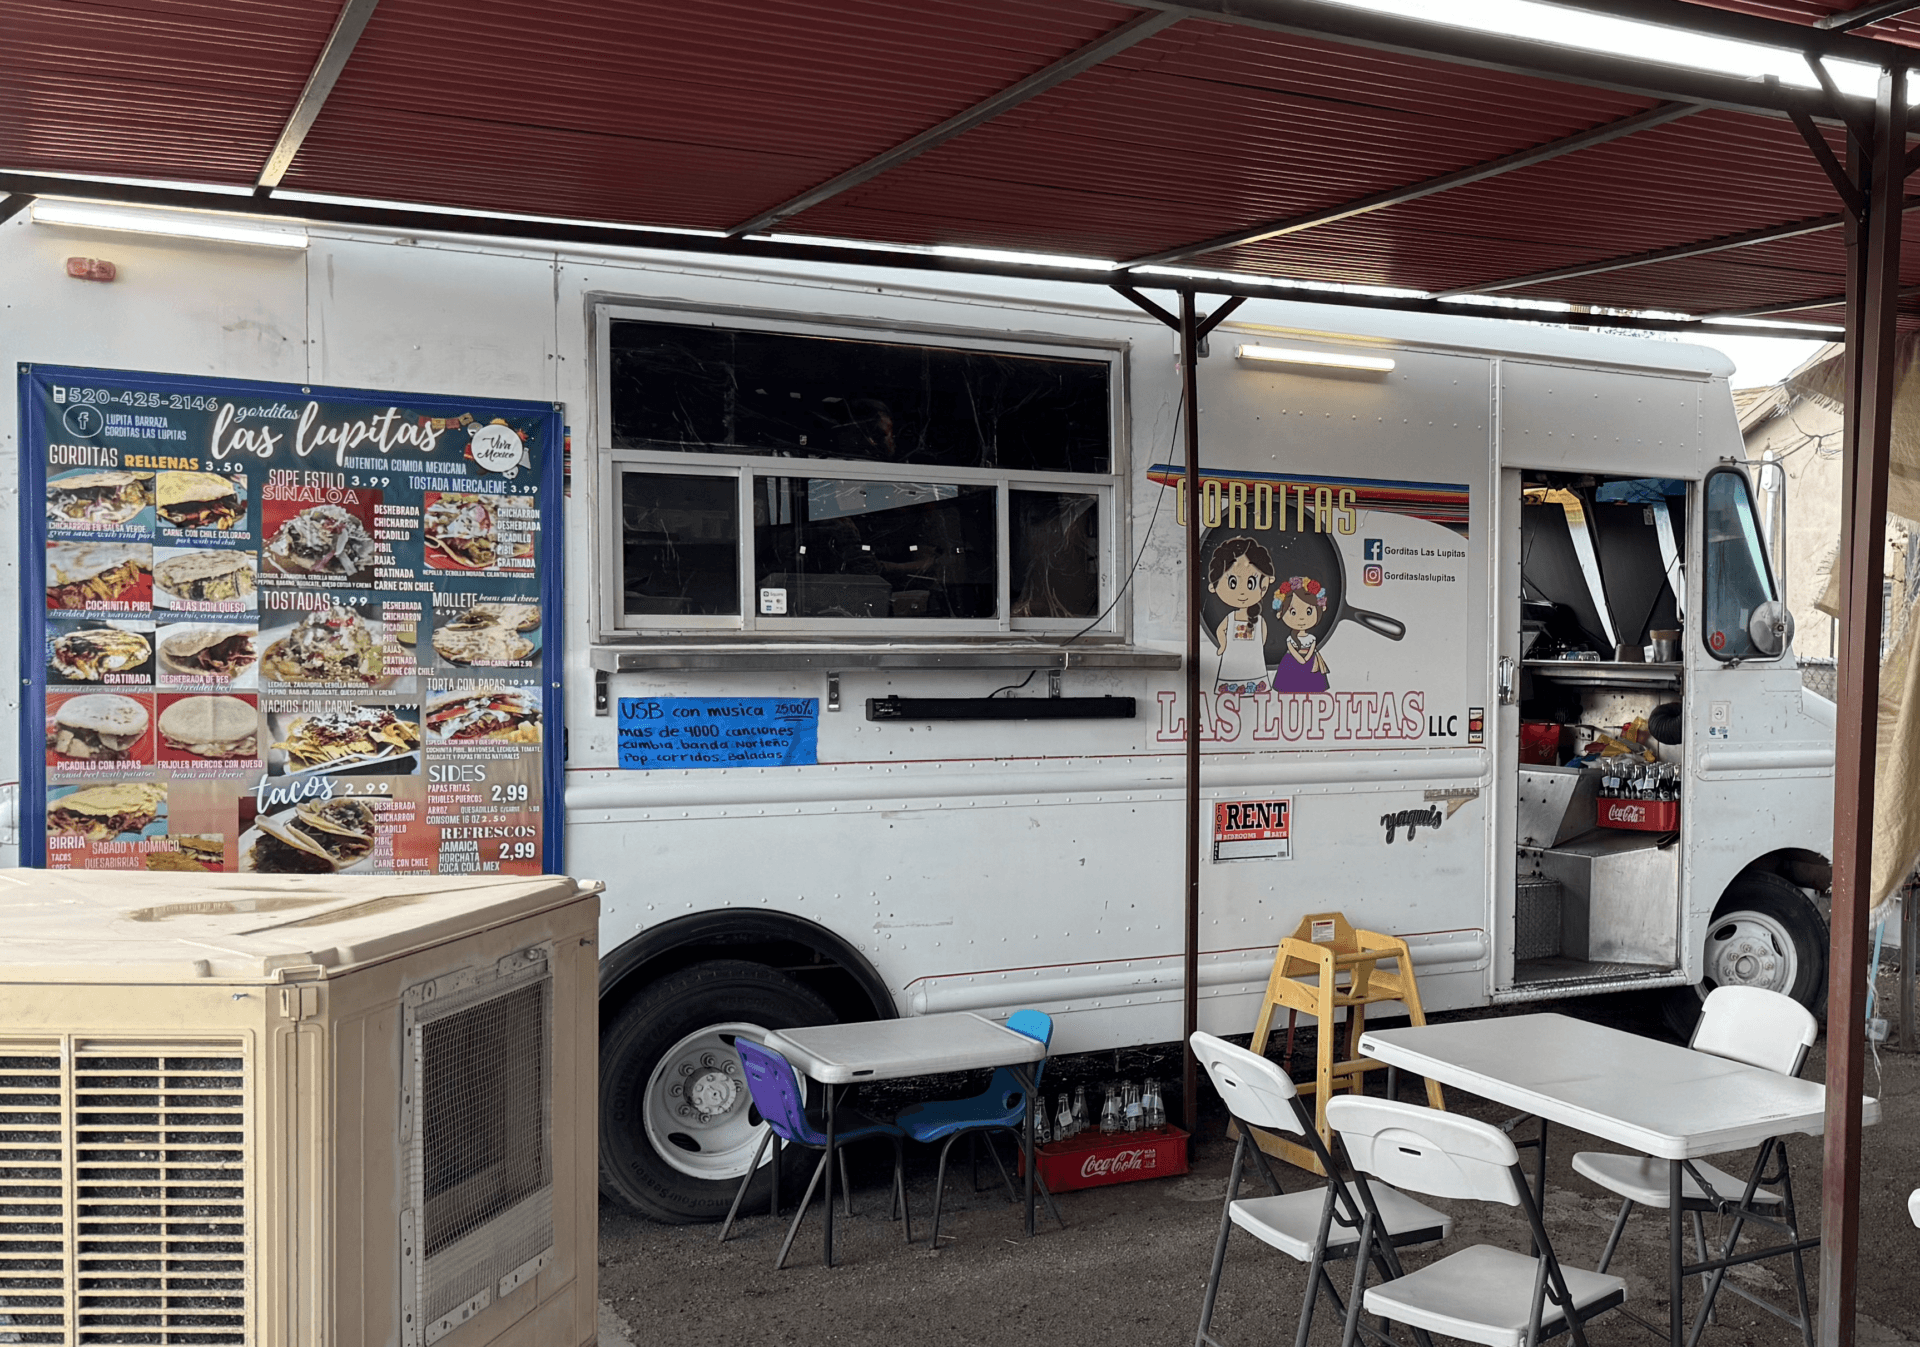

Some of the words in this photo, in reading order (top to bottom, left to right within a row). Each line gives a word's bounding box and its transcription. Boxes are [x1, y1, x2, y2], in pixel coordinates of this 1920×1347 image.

[69, 387, 219, 412] 520-425-2146
[234, 403, 301, 423] gorditas
[106, 414, 132, 426] LUPITA
[134, 415, 168, 428] BARRAZA
[105, 426, 139, 438] GORDITAS
[142, 427, 155, 438] LAS
[157, 428, 187, 440] LUPITAS
[211, 402, 283, 460] las
[295, 401, 445, 466] lupitas
[49, 444, 118, 467] GORDITAS
[124, 454, 199, 470] RELLENAS
[205, 462, 243, 474] 3.50
[344, 456, 389, 471] AUTENTICA
[391, 459, 423, 473] COMIDA
[426, 461, 467, 475] MEXICANA
[269, 469, 299, 487] SOPE
[304, 471, 345, 489] ESTILO
[351, 475, 390, 488] 3.99
[409, 475, 449, 492] TOSTADA
[510, 484, 538, 494] 3.99
[261, 485, 360, 505] SINALOA
[374, 505, 420, 516] DESHEBRADA
[497, 508, 540, 519] CHICHARRON
[374, 517, 419, 528] CHICHARRON
[497, 520, 540, 531] DESHEBRADA
[163, 528, 184, 537] CARNE
[185, 529, 198, 538] CON
[199, 529, 217, 539] CHILE
[374, 530, 410, 541] PICADILLO
[497, 532, 531, 543] PICADILLO
[374, 543, 392, 552] PIBIL
[1384, 546, 1418, 556] Gorditas
[1420, 548, 1434, 557] Las
[1436, 548, 1466, 559] Lupitas
[374, 555, 396, 566] RAJAS
[497, 557, 536, 568] GRATINADA
[374, 568, 414, 579] GRATINADA
[1384, 571, 1456, 583] Gorditaslaslupitas
[374, 581, 398, 590] CARNE
[399, 582, 413, 591] CON
[414, 582, 434, 592] CHILE
[85, 600, 130, 611] COCHINITA
[132, 600, 152, 611] PIBIL
[263, 590, 332, 611] TOSTADAS
[332, 596, 368, 607] 3.99
[382, 601, 422, 611] DESHEBRADA
[432, 592, 478, 608] MOLLETE
[170, 601, 197, 611] RAJAS
[219, 602, 246, 612] QUESO
[382, 612, 422, 621] CHICHARRON
[382, 623, 414, 632] PICADILLO
[382, 645, 401, 654] RAJAS
[382, 656, 417, 665] GRATINADA
[382, 666, 403, 676] CARNE
[403, 667, 417, 676] CON
[417, 667, 435, 676] CHILE
[104, 673, 152, 685] GRATINADA
[427, 678, 454, 692] TORTA
[457, 678, 475, 691] CON
[478, 678, 506, 692] PAPAS
[260, 700, 299, 713] NACHOS
[302, 700, 322, 713] CON
[325, 701, 356, 713] CARNE
[394, 703, 418, 711] 9.99
[621, 702, 664, 720] USB
[672, 707, 701, 718] con
[707, 703, 764, 718] musica
[1157, 690, 1241, 742] LAS
[1253, 690, 1425, 742] LUPITAS
[1428, 715, 1458, 737] LLC
[619, 726, 653, 737] mas
[658, 725, 680, 738] de
[684, 725, 720, 738] 4000
[725, 726, 794, 737] canciones
[57, 760, 97, 770] PICADILLO
[98, 760, 115, 770] CON
[116, 759, 142, 770] PAPAS
[157, 759, 190, 769] FRIJOLES
[191, 759, 223, 769] PUERCOS
[225, 759, 239, 769] CON
[241, 759, 263, 769] QUESO
[428, 764, 486, 782] SIDES
[249, 774, 338, 814] tacos
[344, 782, 389, 795] 2.99
[427, 784, 448, 793] PAPAS
[449, 784, 471, 792] FRITAS
[491, 784, 528, 803] 2,99
[427, 795, 454, 804] FRIJOLES
[455, 794, 482, 804] PUERCOS
[374, 801, 416, 811] DESHEBRADA
[427, 806, 448, 815] ARROZ
[374, 813, 415, 822] CHICHARRON
[426, 815, 460, 825] CONSOME
[482, 815, 506, 823] 2.50
[1225, 801, 1288, 831] RENT
[374, 825, 407, 833] PICADILLO
[441, 825, 536, 840] REFRESCOS
[49, 836, 86, 850] BIRRIA
[92, 841, 127, 855] SABADO
[129, 841, 135, 853] Y
[138, 840, 180, 853] DOMINGO
[439, 840, 479, 853] JAMAICA
[374, 848, 393, 857] RAJAS
[498, 842, 536, 861] 2,99
[51, 853, 72, 862] TACOS
[85, 857, 140, 870] QUESABIRRIAS
[374, 859, 395, 868] CARNE
[396, 859, 409, 867] CON
[411, 858, 429, 867] CHILE
[439, 852, 480, 864] HORCHATA
[438, 863, 459, 873] COCA
[461, 862, 481, 872] COLA
[483, 861, 500, 872] MEX
